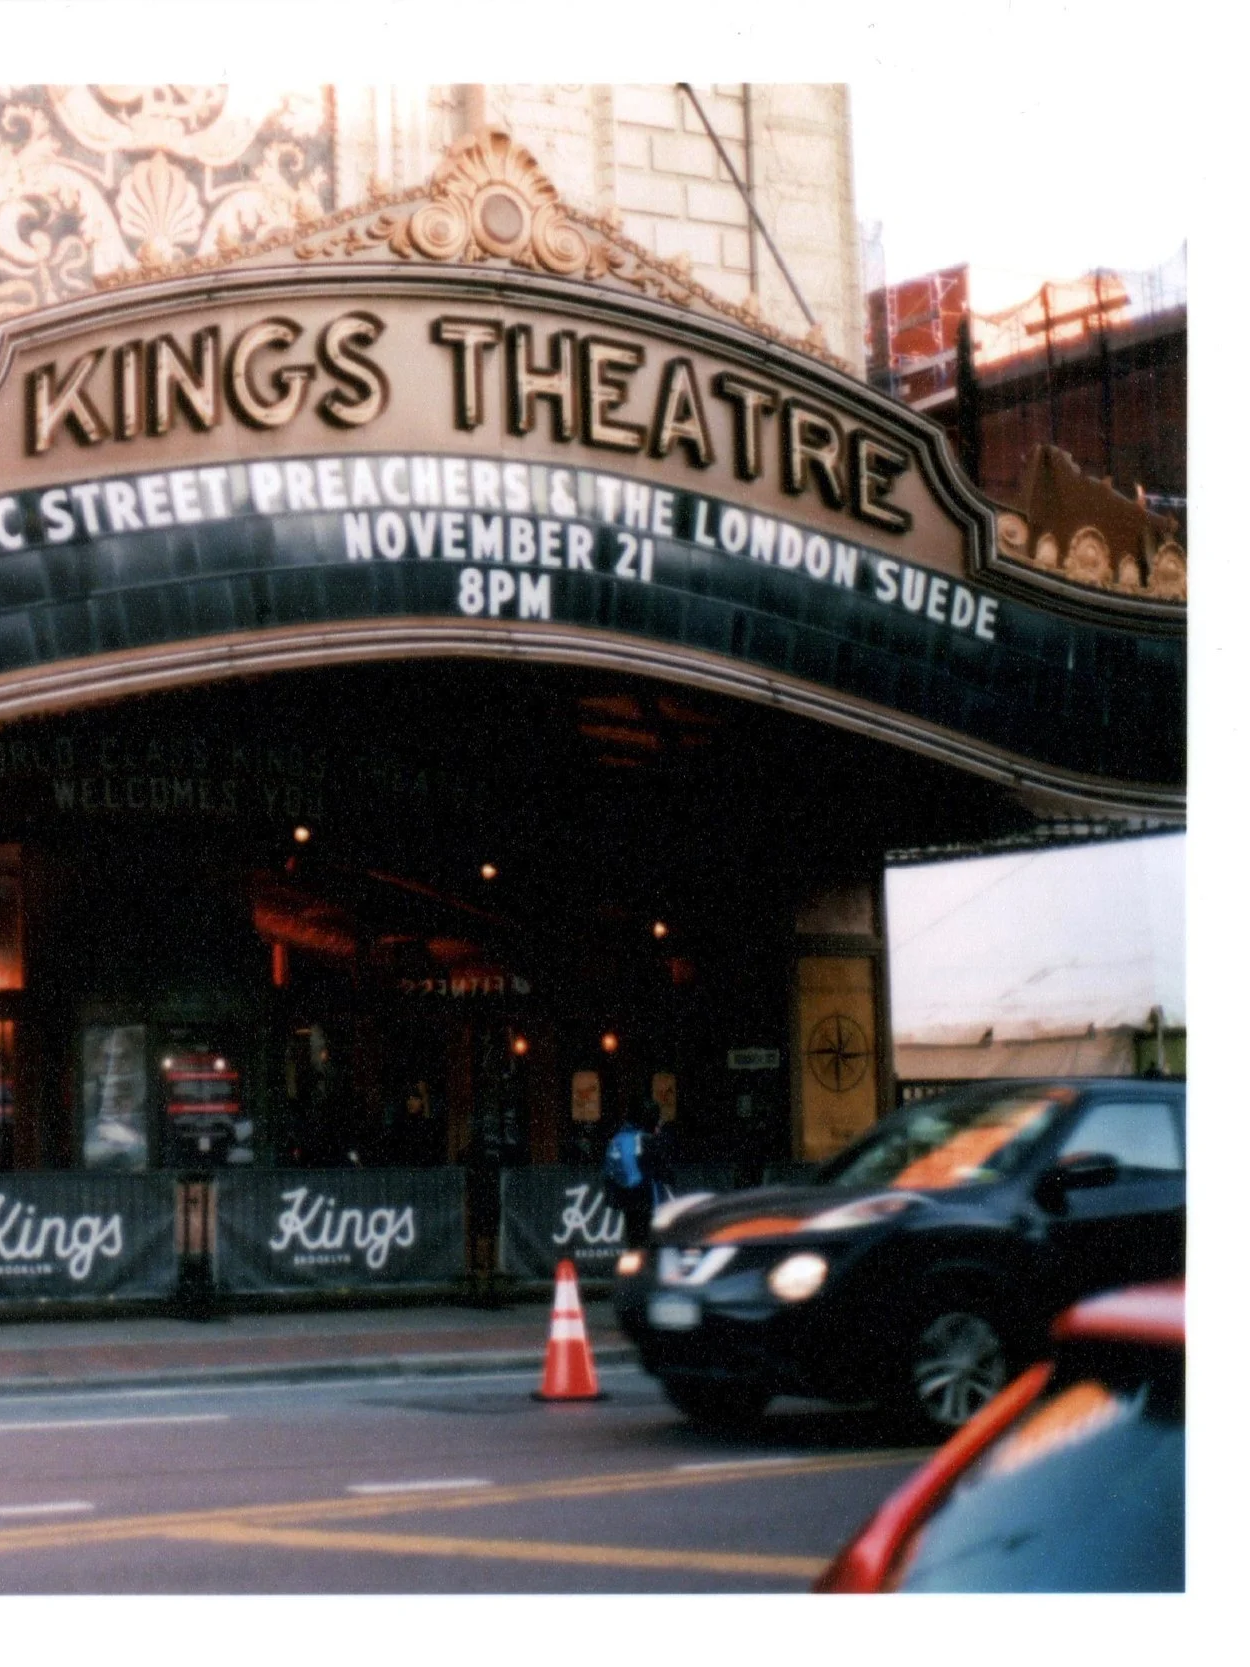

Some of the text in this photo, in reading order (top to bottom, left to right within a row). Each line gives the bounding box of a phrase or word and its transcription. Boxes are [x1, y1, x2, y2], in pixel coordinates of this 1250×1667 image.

[25, 311, 915, 534] KINGS THEATRE
[41, 467, 229, 543] STREET
[254, 455, 529, 514] PREACHERS
[551, 474, 577, 517] &
[594, 478, 675, 535] THE
[694, 499, 857, 588] LONDON
[875, 558, 999, 641] SUEDE
[345, 511, 654, 582] NOVEMBER 21
[458, 568, 551, 620] 8PM
[52, 777, 238, 812] WELCOMES
[269, 1186, 415, 1269] Kings
[294, 1253, 350, 1265] BROOKLYN
